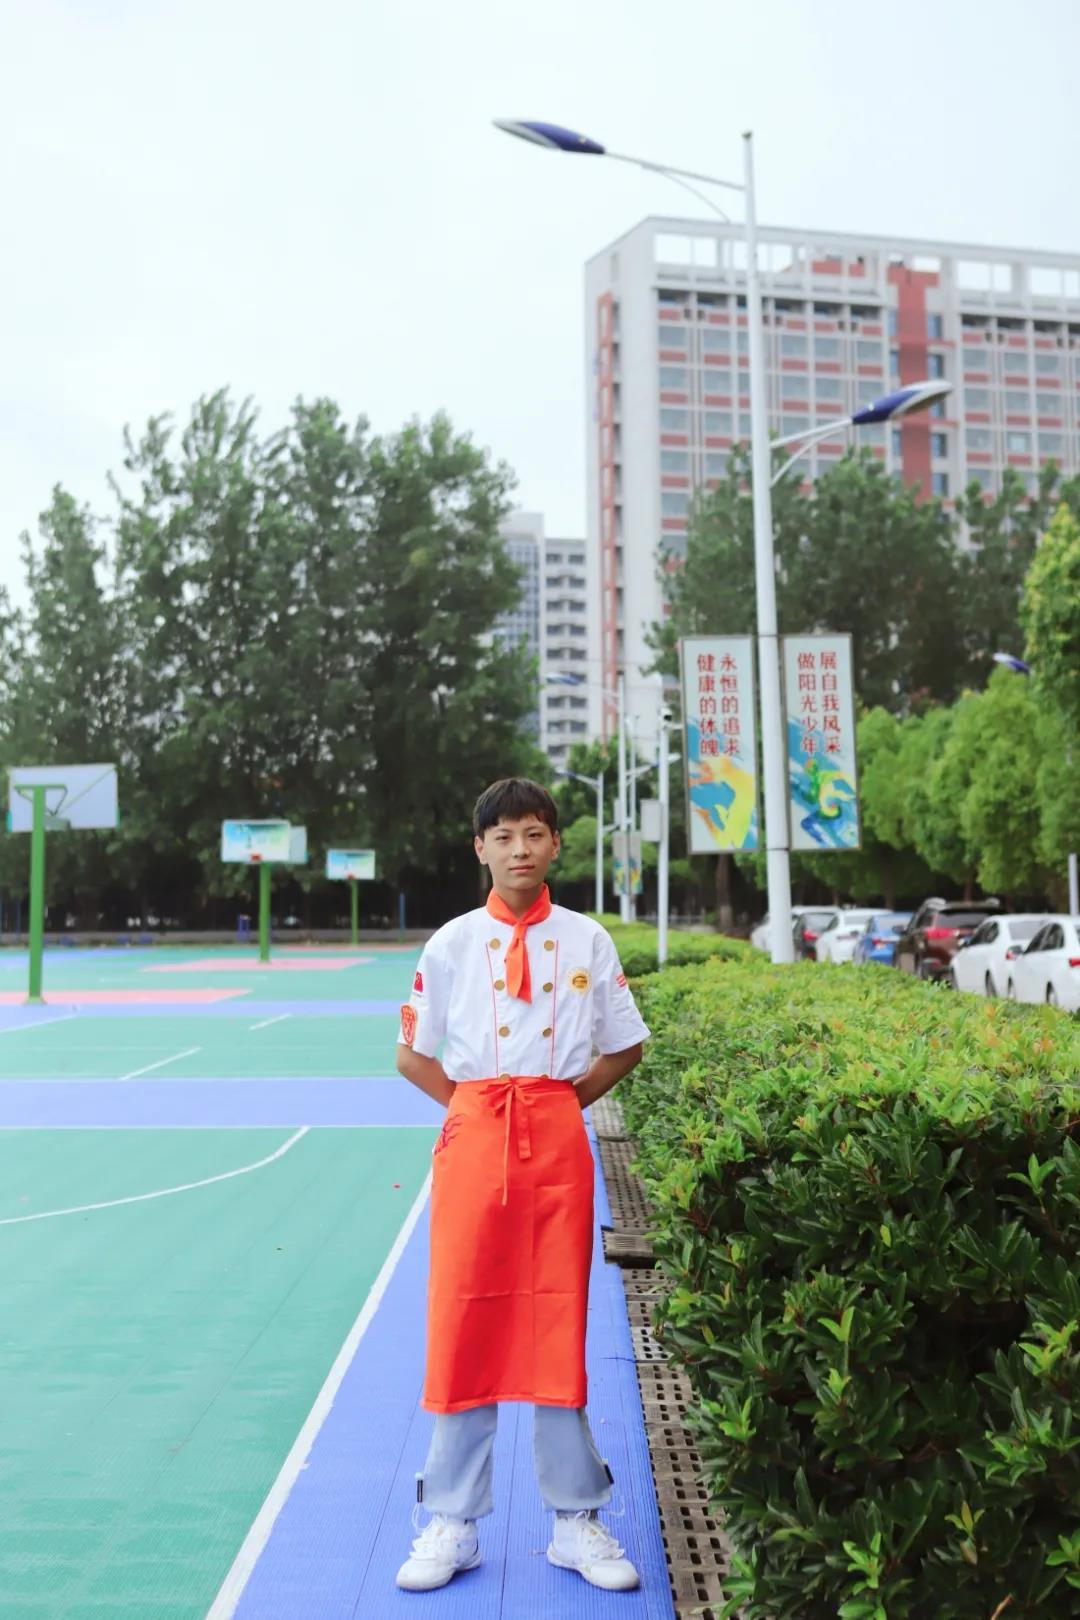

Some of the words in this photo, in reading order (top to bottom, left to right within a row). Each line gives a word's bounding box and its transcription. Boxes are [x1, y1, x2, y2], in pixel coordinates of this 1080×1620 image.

[697, 653, 719, 757] 健康的体魄
[720, 653, 740, 756] 永恒的追求
[797, 652, 818, 755] 做阳光少年
[820, 652, 841, 754] 展自我风采
